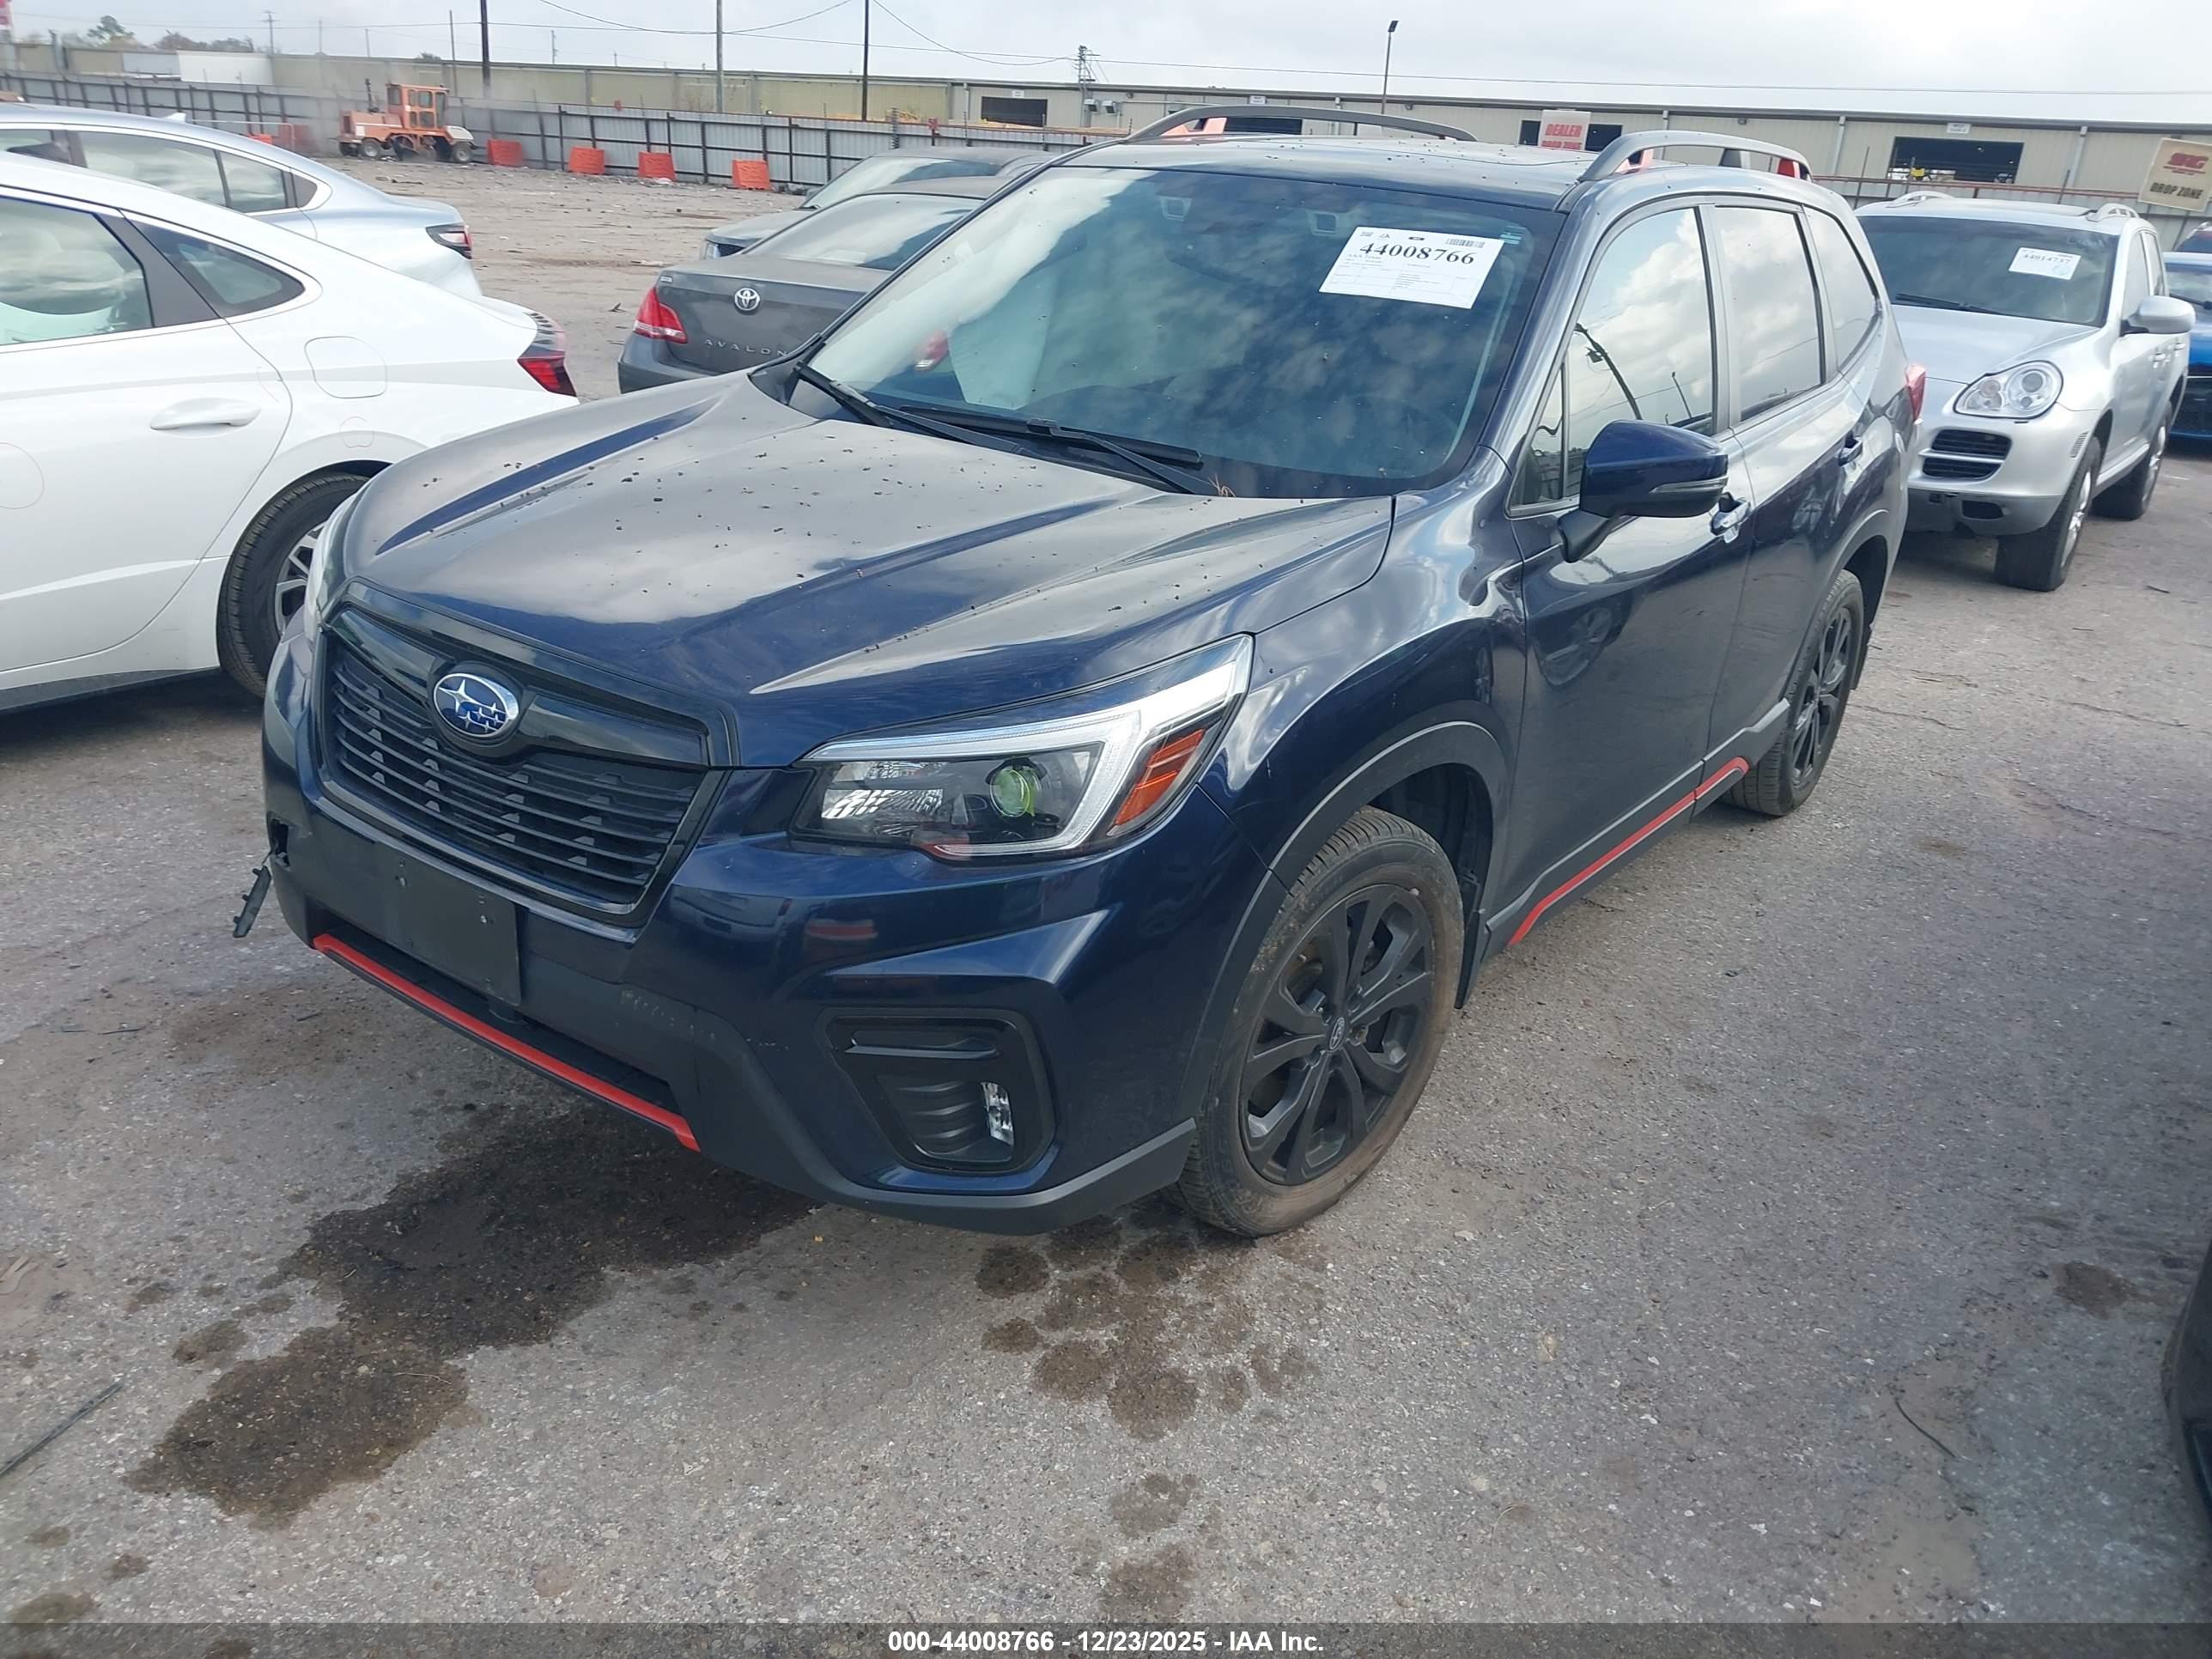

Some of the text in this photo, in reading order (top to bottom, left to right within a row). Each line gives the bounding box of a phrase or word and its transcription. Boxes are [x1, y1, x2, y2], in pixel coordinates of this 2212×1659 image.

[1545, 123, 1583, 137] DEALER
[2149, 182, 2204, 200] DROP ZONE
[1359, 242, 1478, 265] 44008766
[704, 338, 788, 357] AVALON
